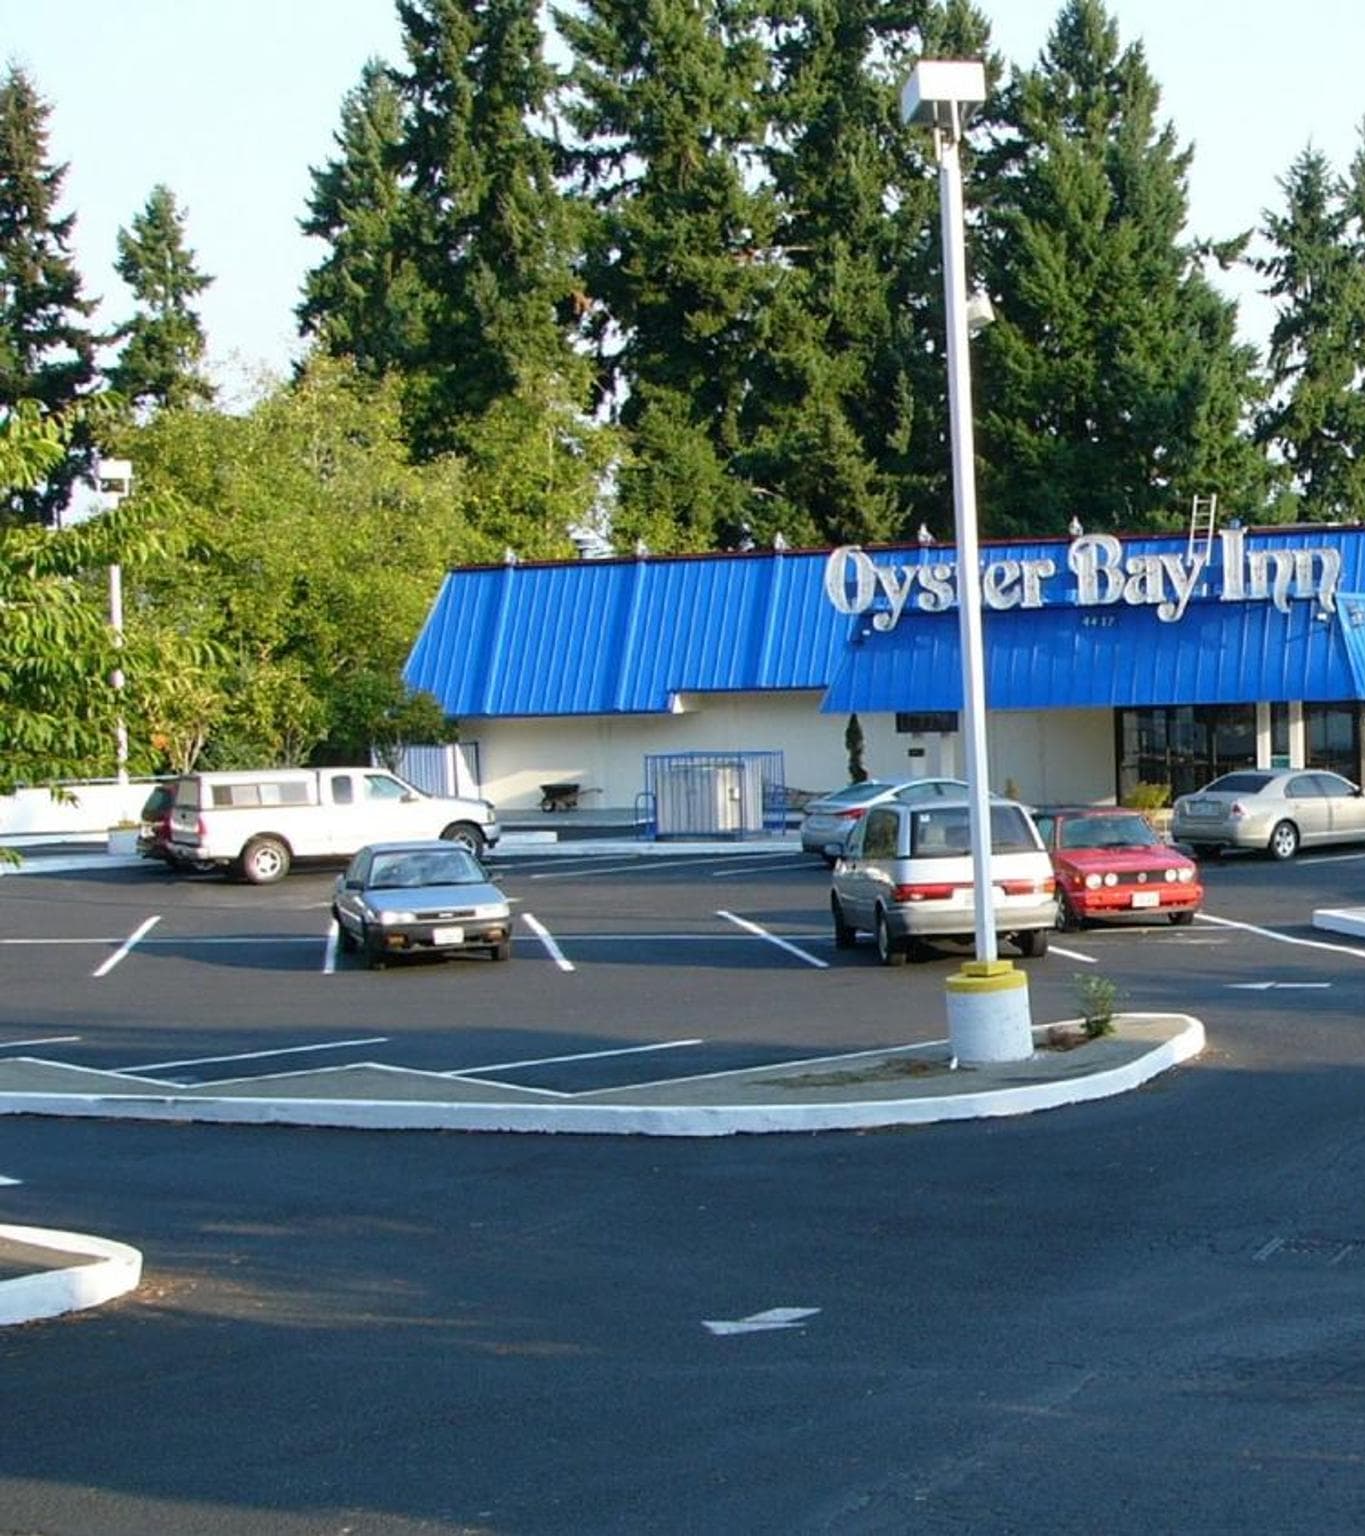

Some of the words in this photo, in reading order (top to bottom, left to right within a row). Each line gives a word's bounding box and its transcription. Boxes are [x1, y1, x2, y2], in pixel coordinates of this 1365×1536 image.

[825, 545, 1056, 632] Oyser
[1068, 534, 1208, 622] Bay
[1219, 526, 1341, 613] Inn
